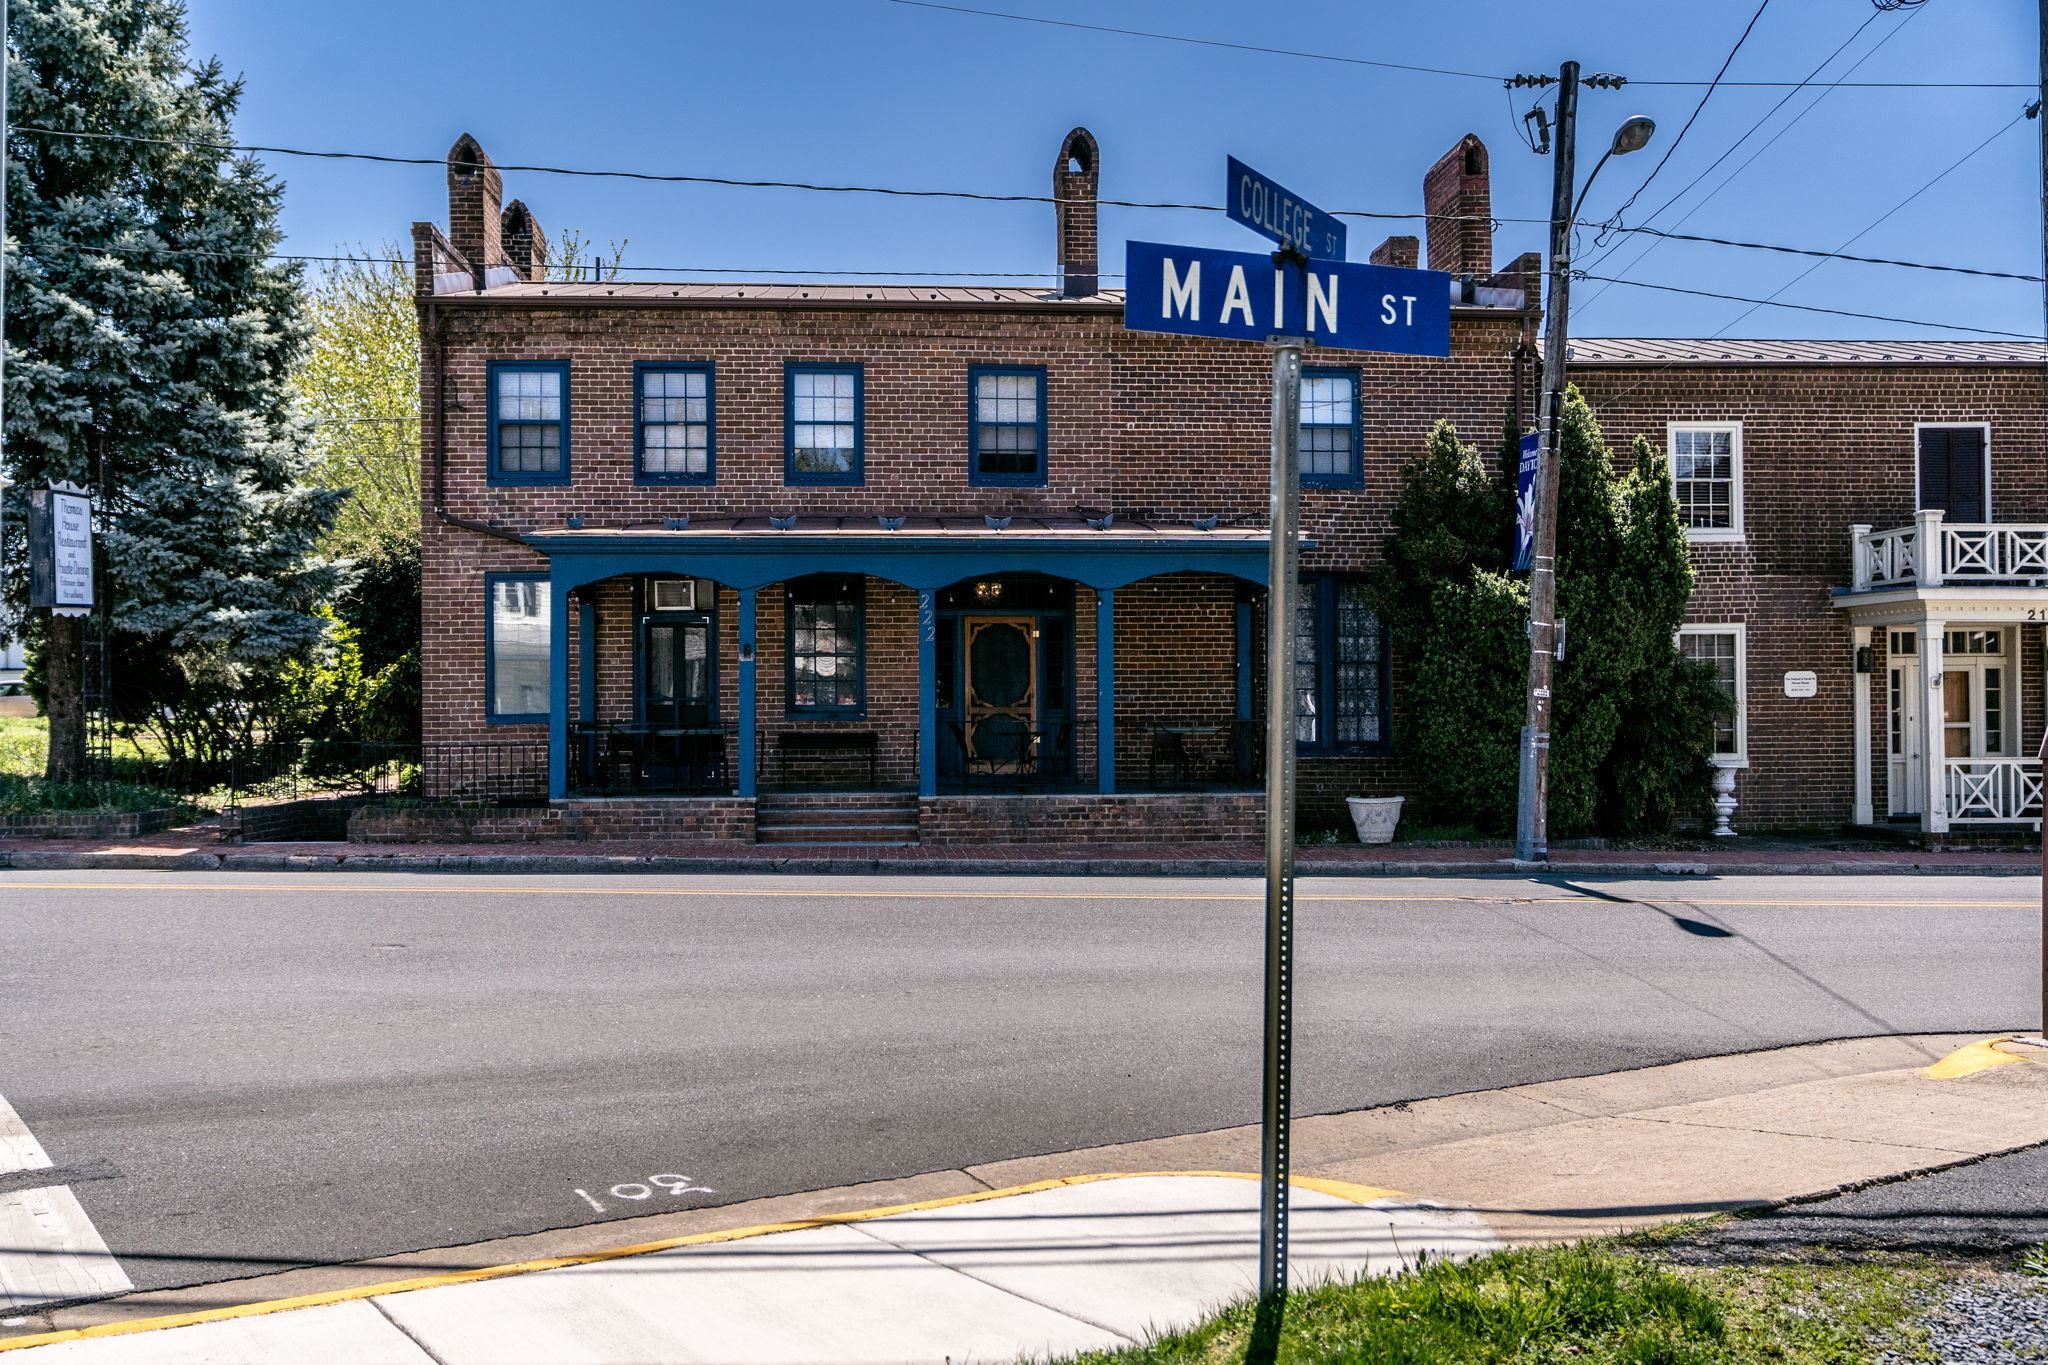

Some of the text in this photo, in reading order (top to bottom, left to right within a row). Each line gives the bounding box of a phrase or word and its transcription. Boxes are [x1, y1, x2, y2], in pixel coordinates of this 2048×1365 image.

[1240, 174, 1337, 255] COLLEGE ST
[1162, 257, 1417, 334] MAIN ST
[1519, 458, 1537, 473] DAYTO
[60, 499, 82, 515] Thomas
[62, 516, 79, 531] House
[58, 532, 87, 548] Restaurant
[73, 560, 89, 578] Dining
[919, 593, 936, 642] 222
[2028, 610, 2045, 620] 21
